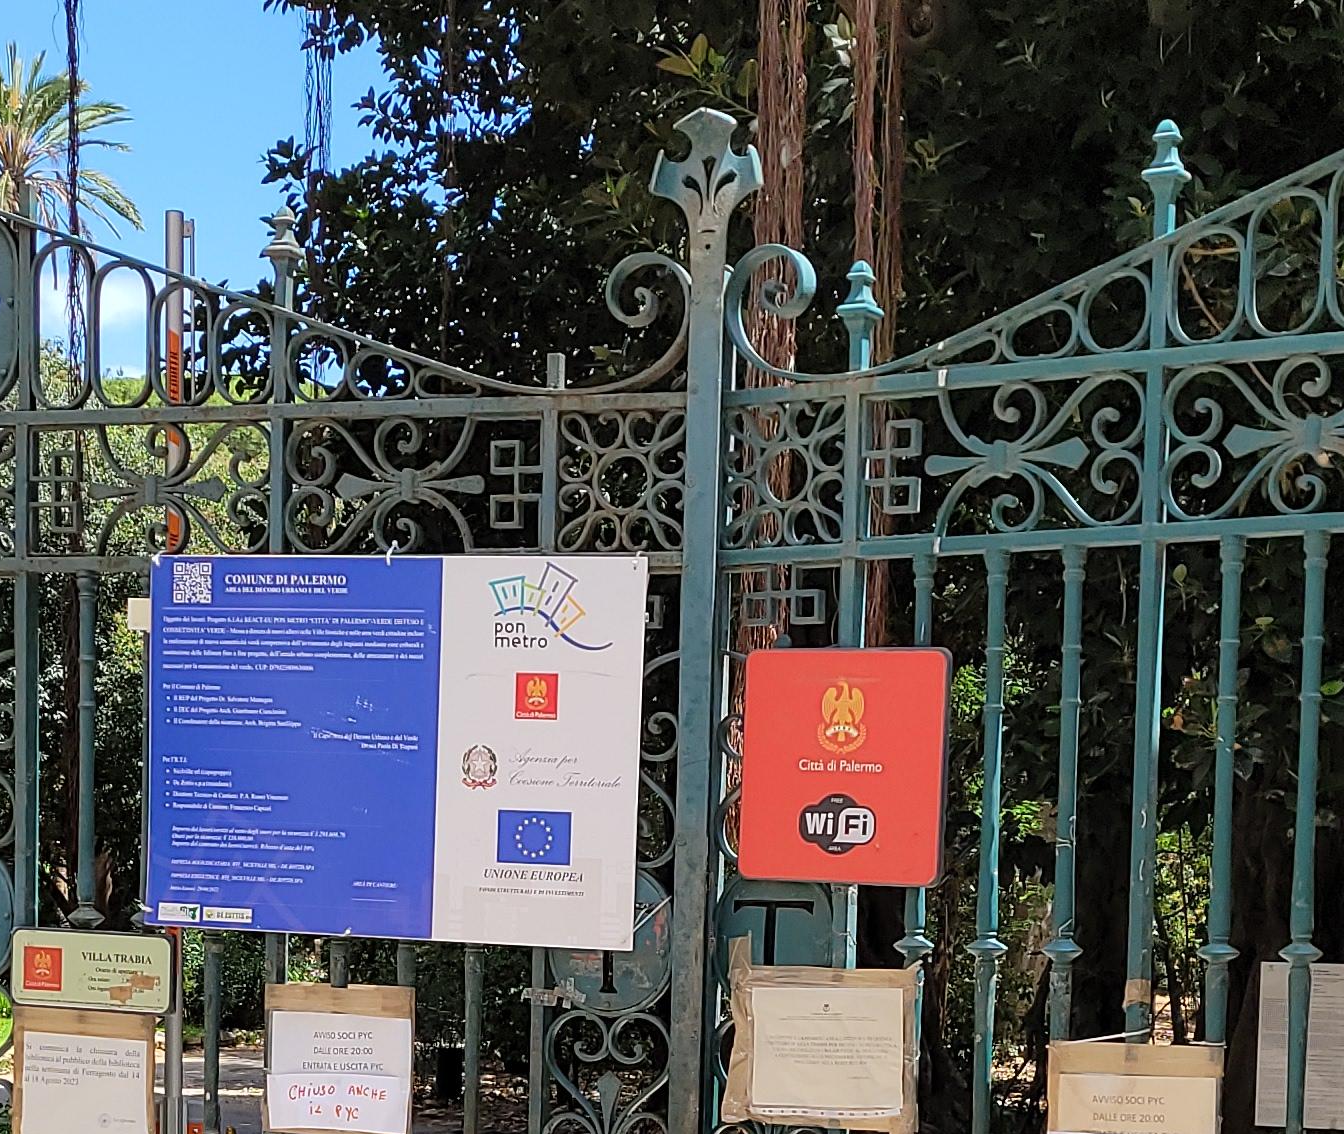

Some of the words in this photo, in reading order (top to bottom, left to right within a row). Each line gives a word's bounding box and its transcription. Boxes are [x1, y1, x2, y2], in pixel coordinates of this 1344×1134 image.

[225, 574, 273, 585] COMUNE
[276, 575, 288, 585] DI
[291, 575, 347, 586] PALERMO
[494, 622, 525, 636] pon
[494, 635, 548, 648] metro
[508, 748, 558, 768] Agenzia
[799, 759, 824, 771] Città
[827, 760, 837, 771] di
[840, 760, 883, 773] Palermo
[484, 868, 528, 880] UNIONE
[530, 871, 584, 882] EUROPEA
[81, 952, 113, 962] VILLA
[114, 954, 152, 965] TRABIA
[313, 1032, 336, 1040] AVVISO
[337, 1032, 356, 1040] SOCI
[358, 1032, 373, 1040] PYC
[313, 1047, 331, 1055] DALLE
[333, 1047, 349, 1055] ORE
[303, 1062, 332, 1070] ENTRATA
[340, 1063, 368, 1071] USCITA
[370, 1063, 384, 1071] PYC
[348, 1084, 387, 1100] ANCHE
[1092, 1095, 1124, 1104] AVVISO
[1125, 1096, 1145, 1105] SOCI
[1147, 1096, 1165, 1105] PYC
[335, 1104, 359, 1122] PYC
[1093, 1112, 1117, 1121] DALLE
[1119, 1113, 1137, 1122] ORE
